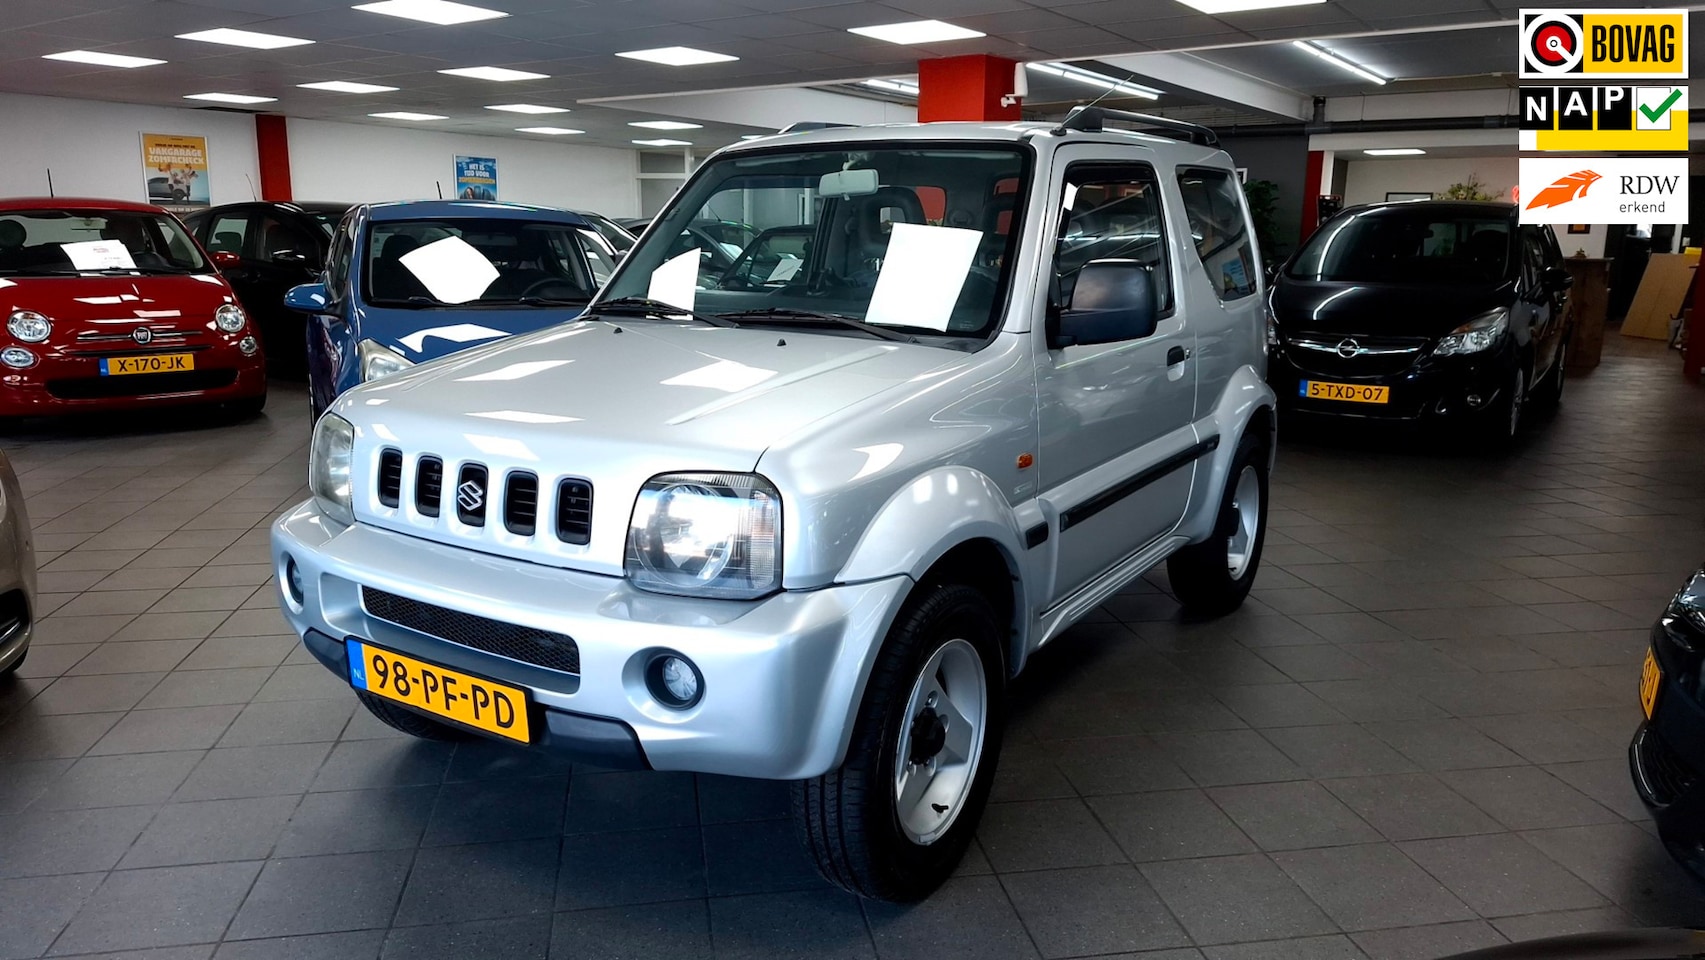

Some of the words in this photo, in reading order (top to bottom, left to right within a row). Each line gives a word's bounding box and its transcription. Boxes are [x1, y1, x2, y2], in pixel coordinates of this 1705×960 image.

[149, 147, 202, 157] VAKGARAGE
[118, 357, 185, 373] X-170-JK
[1312, 383, 1384, 401] 5-TXD-07
[353, 669, 365, 681] NL
[372, 654, 515, 729] 98-PF-PD
